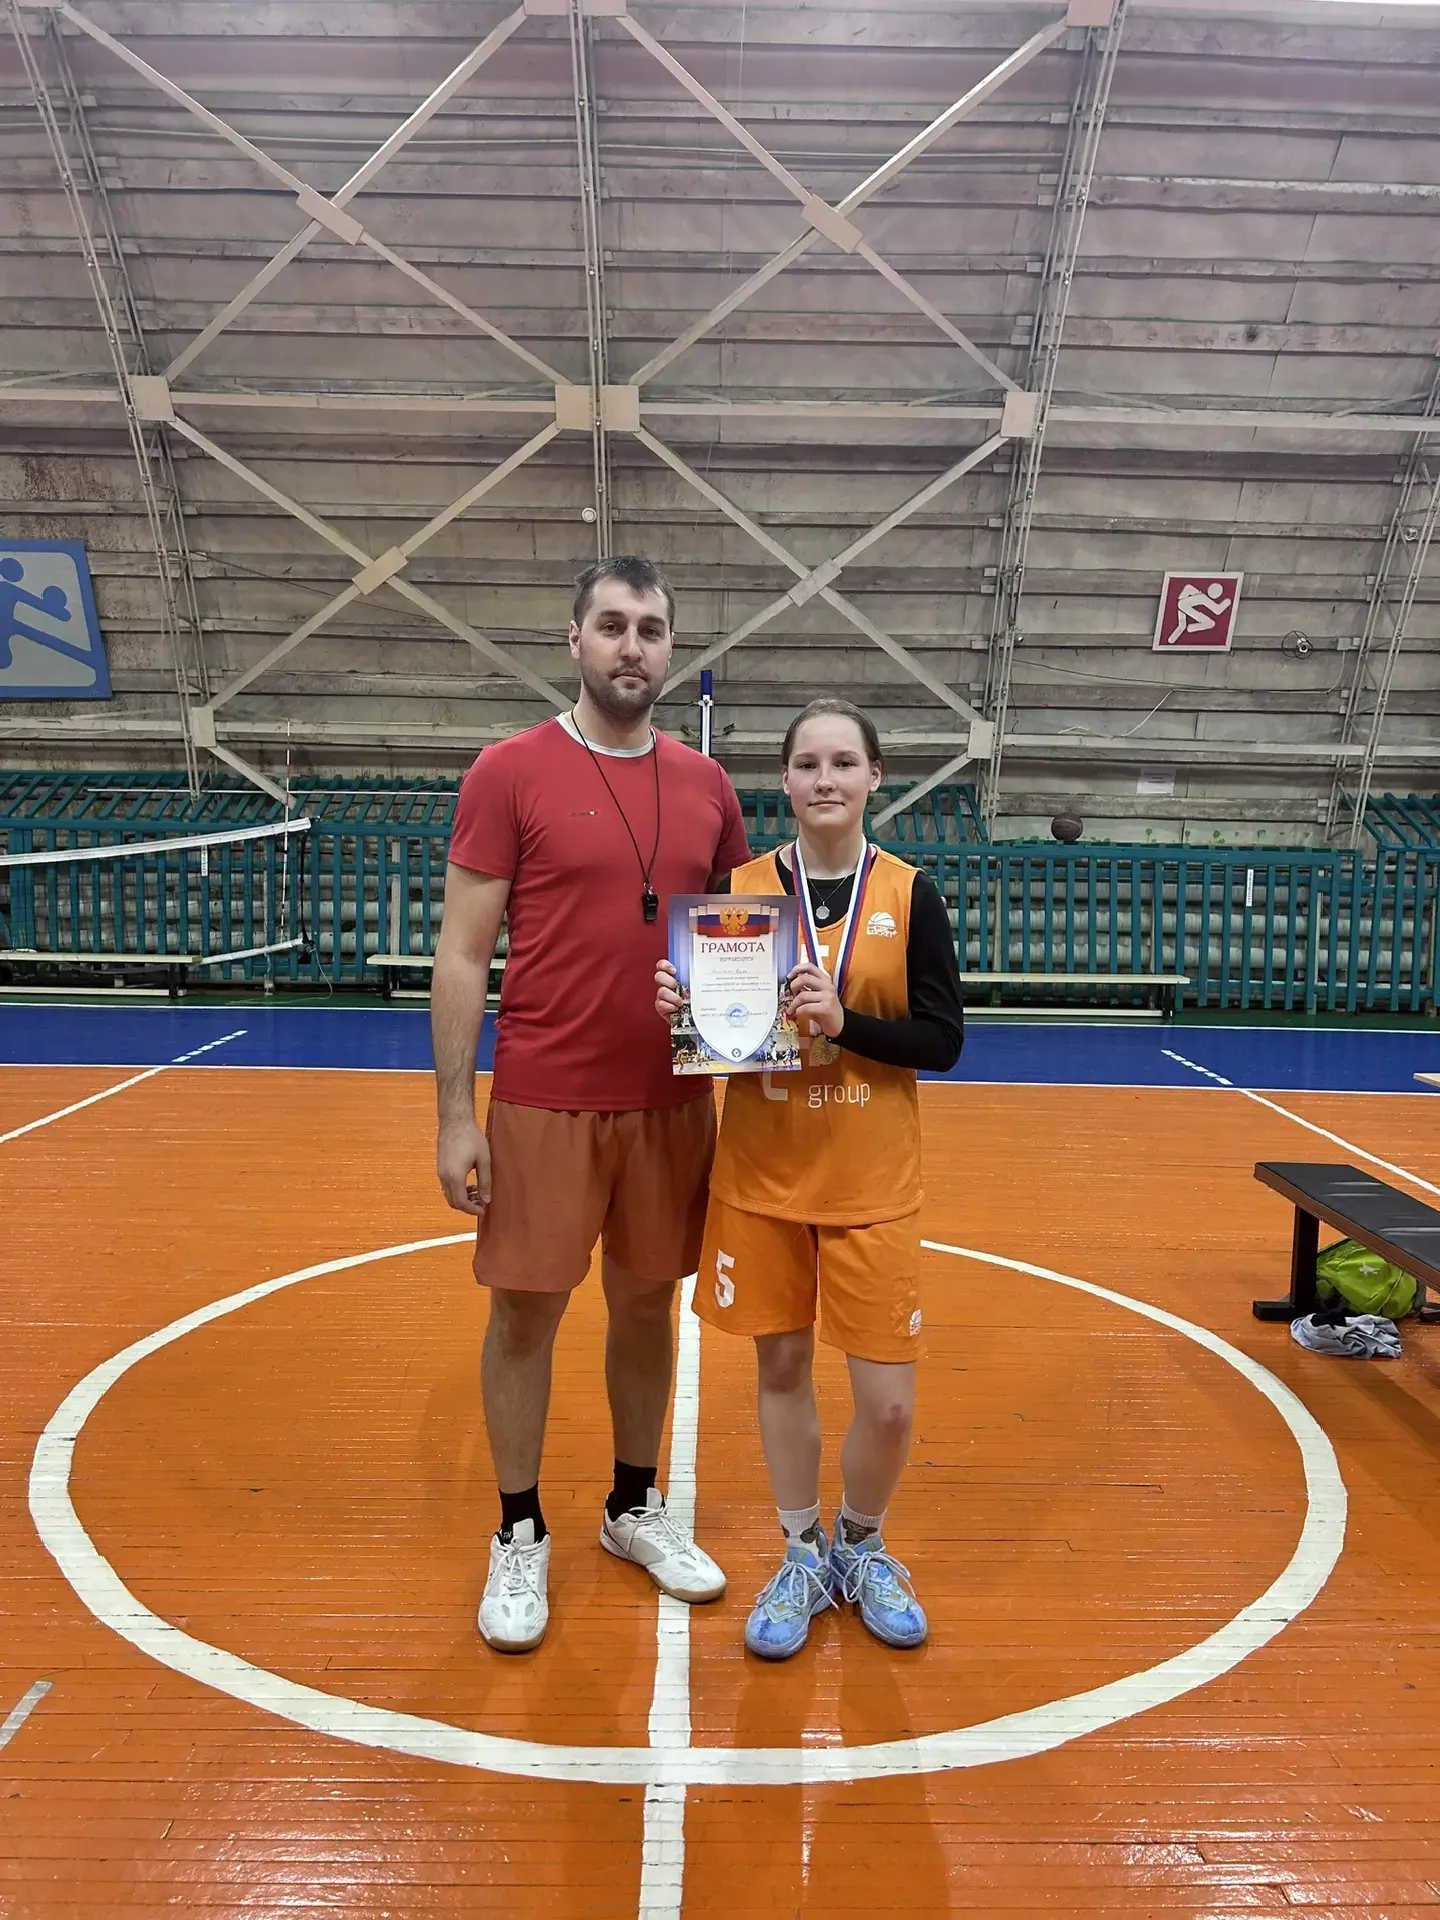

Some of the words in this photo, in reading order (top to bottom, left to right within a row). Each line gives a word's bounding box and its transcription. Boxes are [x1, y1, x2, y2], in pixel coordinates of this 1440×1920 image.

[701, 942, 766, 953] ГРАМОТА
[808, 1083, 871, 1108] group
[715, 1249, 735, 1308] 5
